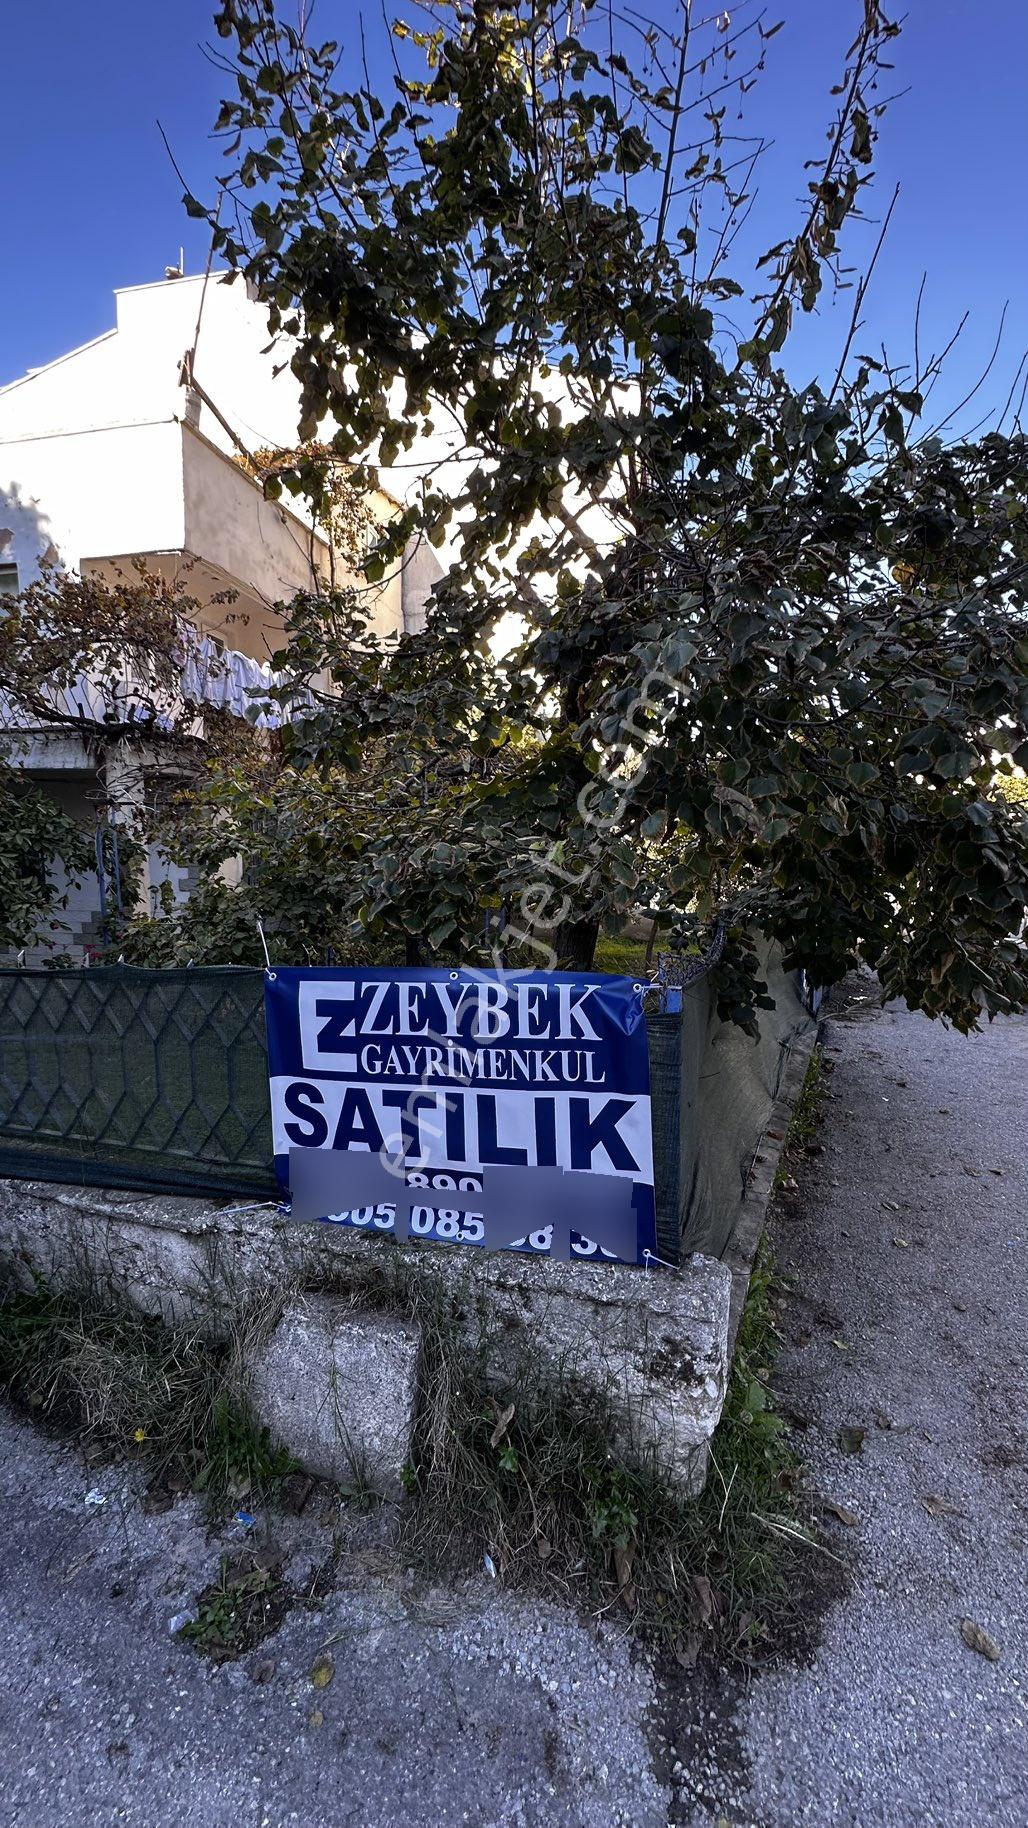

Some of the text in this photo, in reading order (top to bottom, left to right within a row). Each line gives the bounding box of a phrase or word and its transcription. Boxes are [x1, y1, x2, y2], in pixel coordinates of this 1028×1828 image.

[360, 981, 603, 1042] ZEYBEK
[360, 1038, 606, 1084] GAYRİMENKUL
[283, 1081, 642, 1173] SATILIK
[411, 1205, 485, 1241] 085
